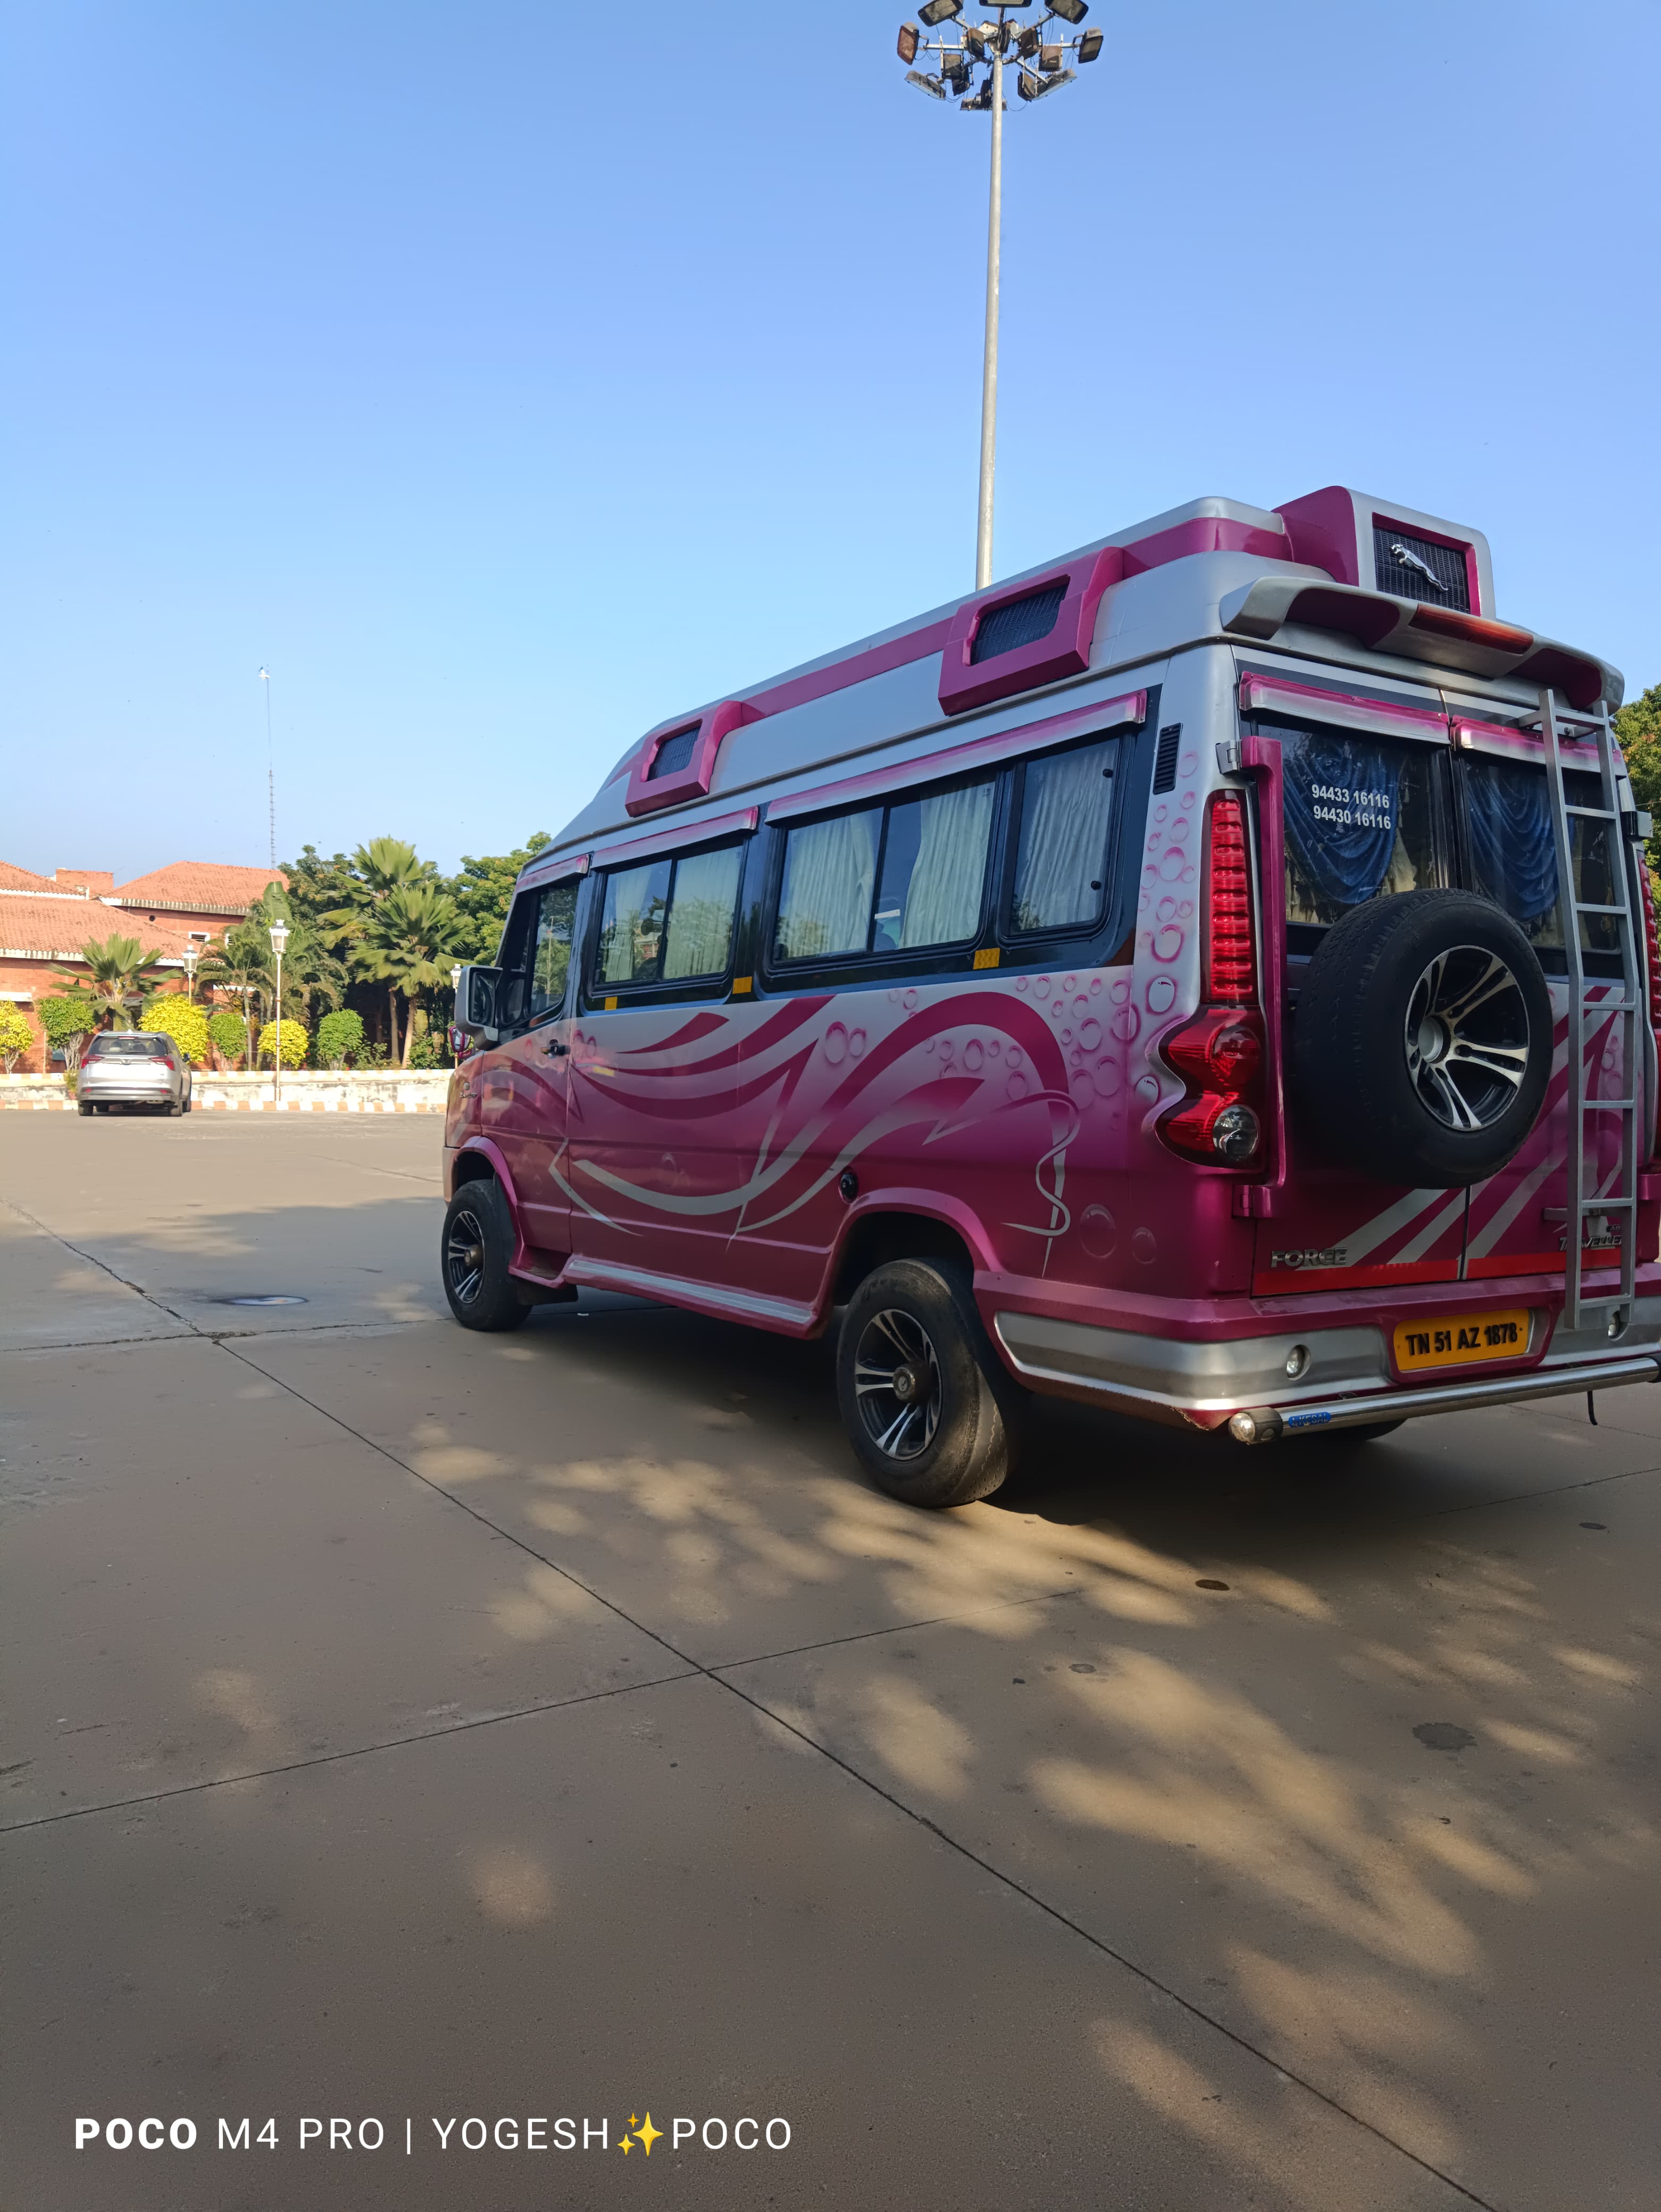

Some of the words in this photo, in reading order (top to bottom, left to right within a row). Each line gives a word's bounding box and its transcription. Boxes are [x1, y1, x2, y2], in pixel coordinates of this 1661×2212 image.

[1312, 784, 1350, 803] 94433
[1353, 790, 1390, 809] 16116
[1313, 805, 1351, 824] 94430
[1355, 811, 1391, 830] 16116
[1559, 1235, 1622, 1251] TVELLE
[1271, 1247, 1348, 1268] FORCE
[1405, 1333, 1430, 1355] TN
[1434, 1330, 1452, 1352] 51
[1457, 1327, 1481, 1350] AZ
[1484, 1322, 1518, 1346] 1878
